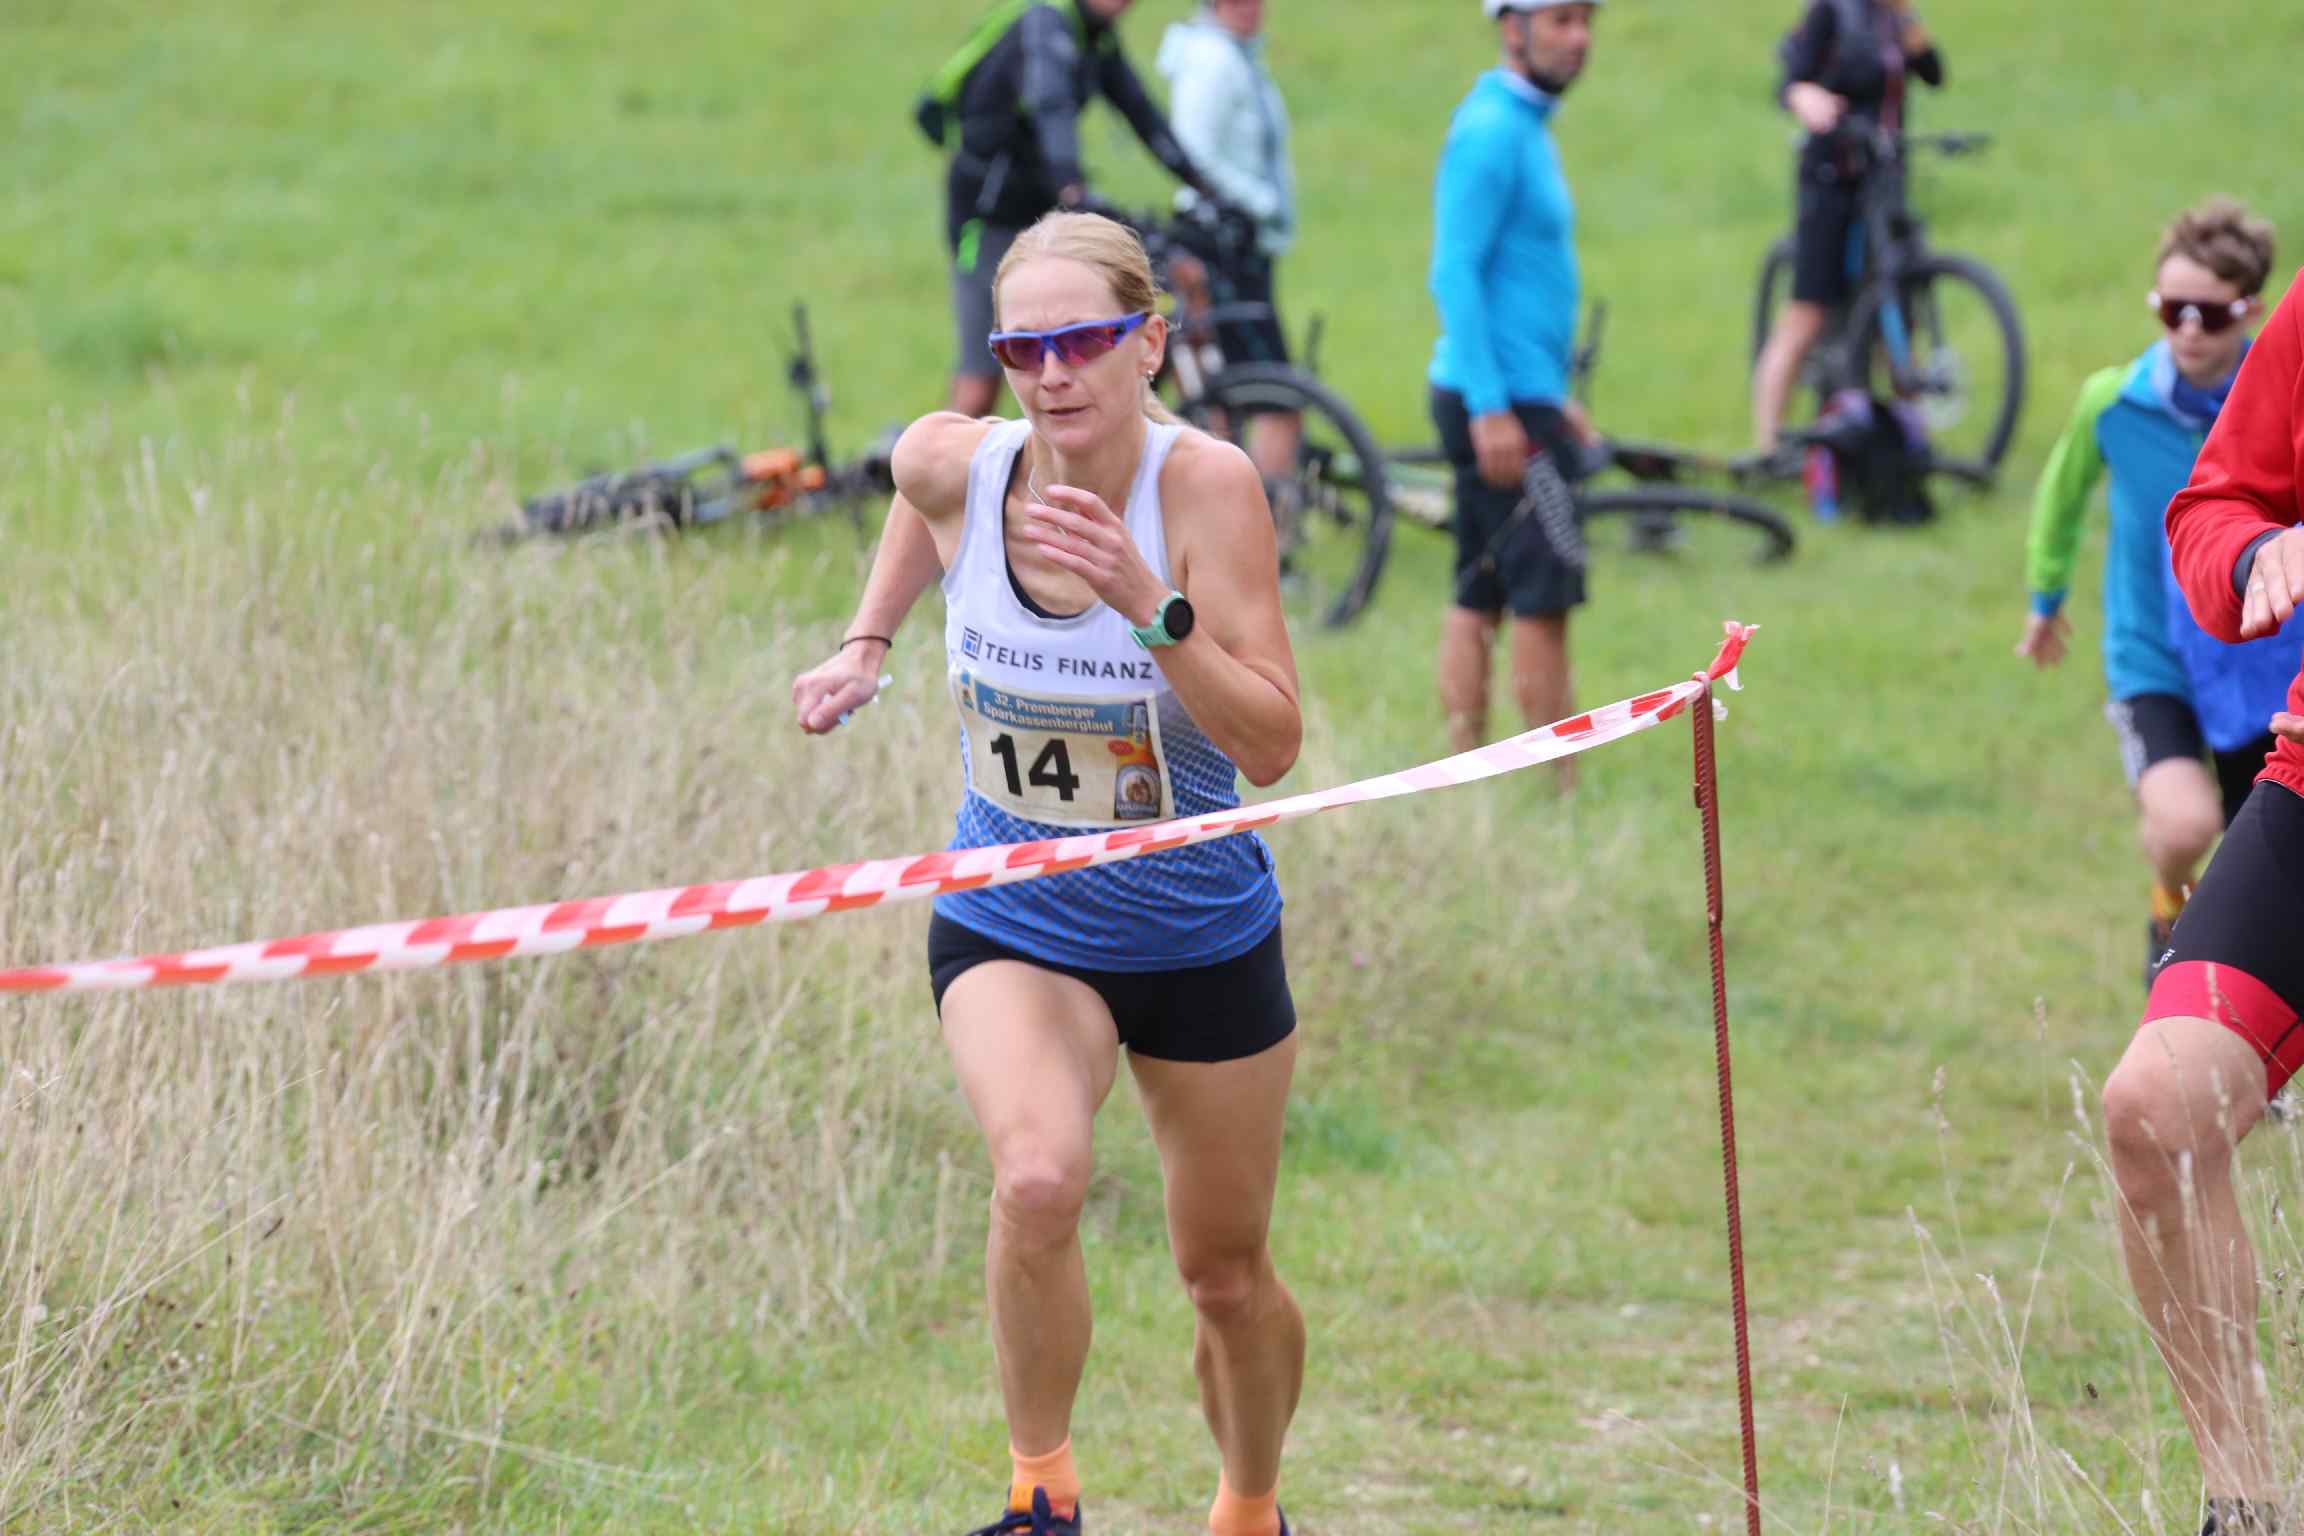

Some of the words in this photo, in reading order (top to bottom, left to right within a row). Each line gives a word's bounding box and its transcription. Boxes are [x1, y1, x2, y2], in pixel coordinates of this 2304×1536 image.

[985, 642, 1044, 671] TELIS
[1058, 657, 1153, 680] FINANZ
[983, 702, 1114, 733] Sparkassenberglauf
[1015, 698, 1096, 719] Premberger
[990, 733, 1080, 802] 14
